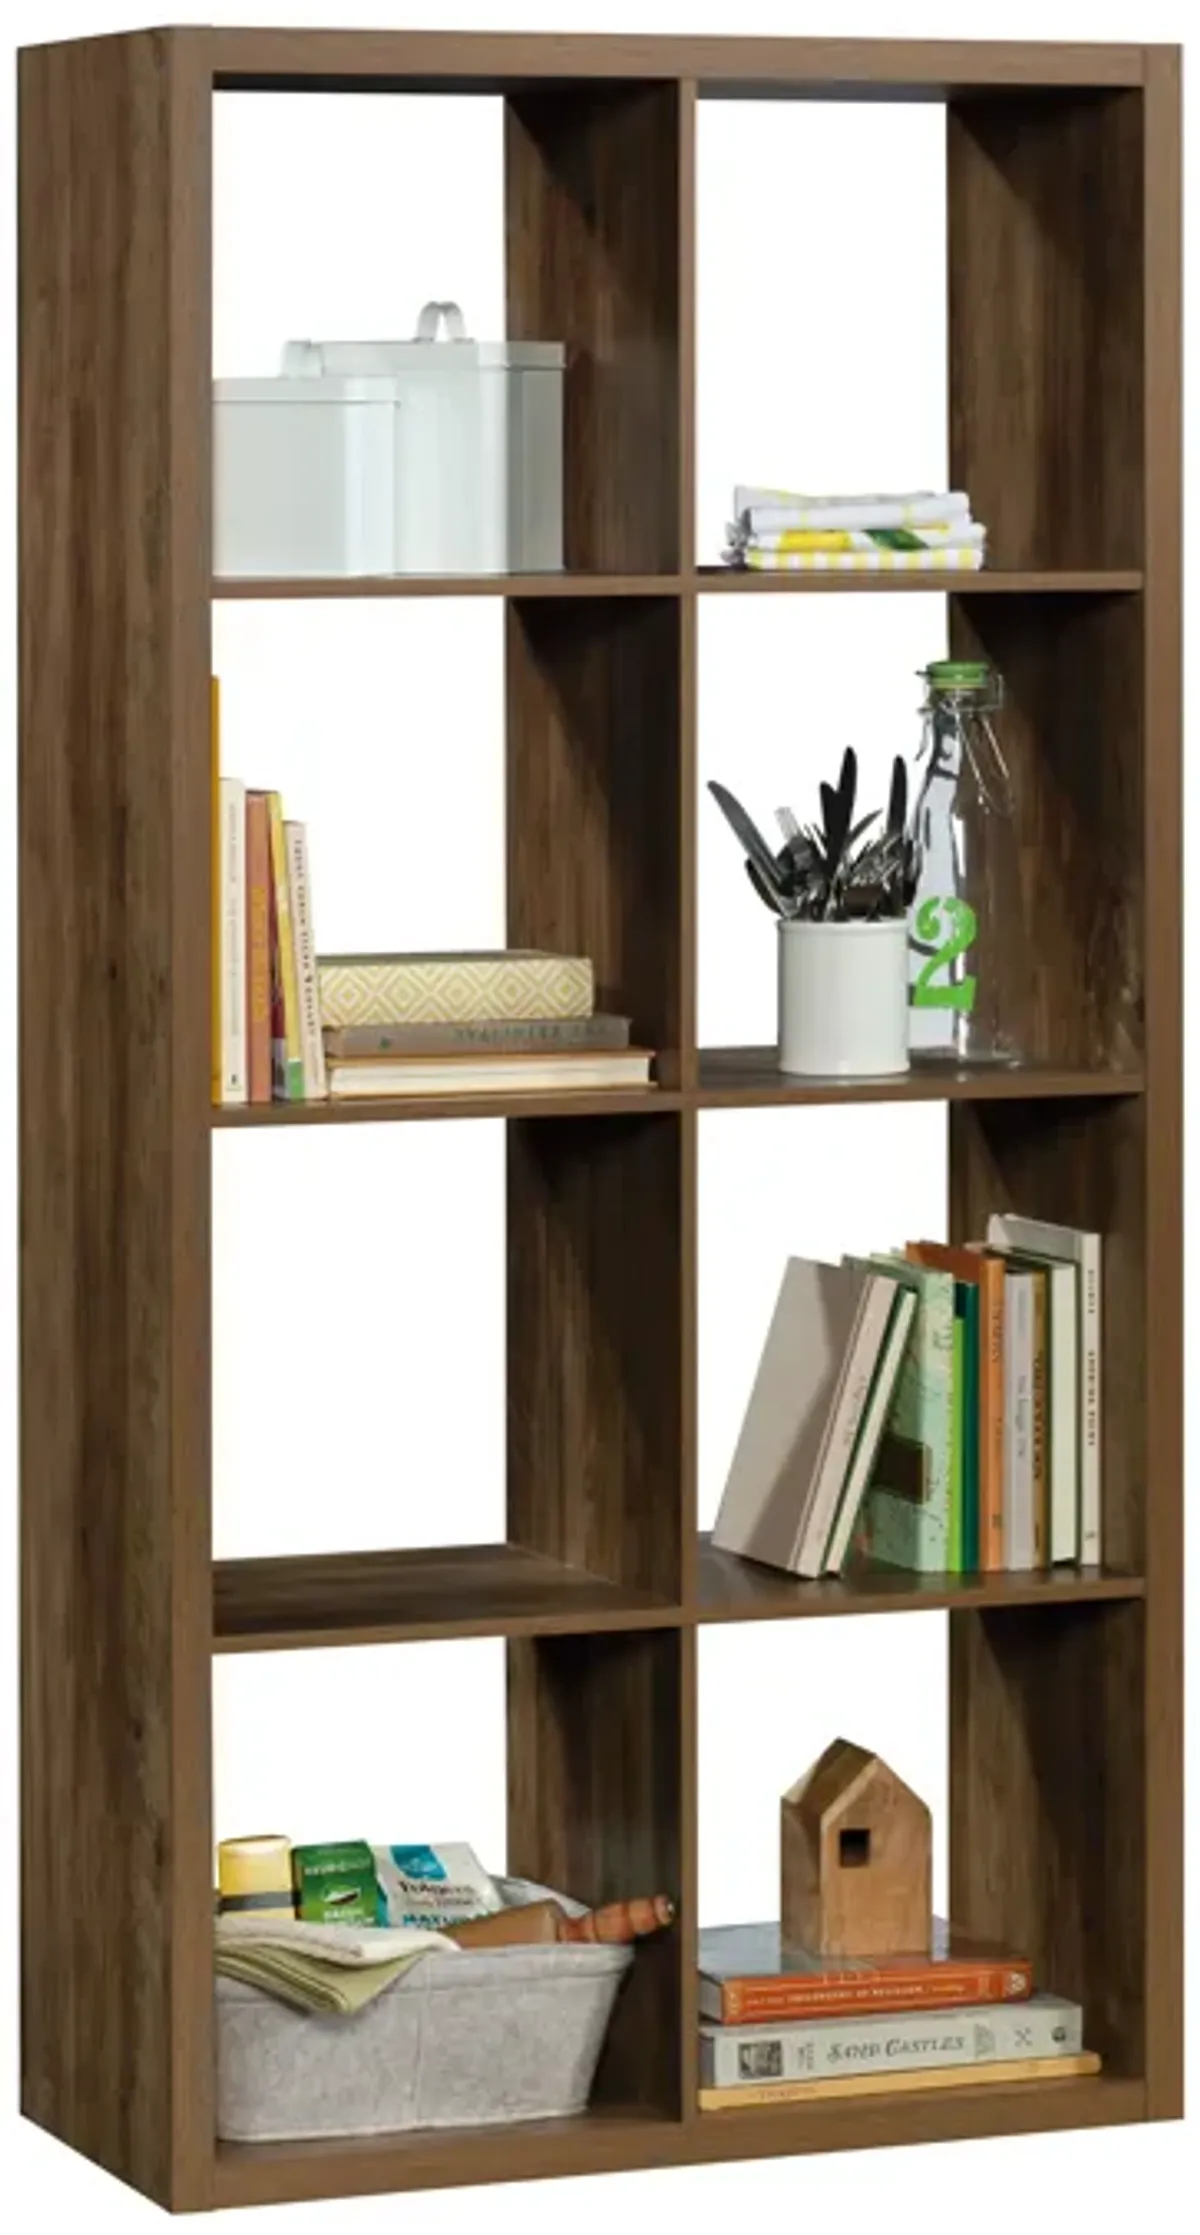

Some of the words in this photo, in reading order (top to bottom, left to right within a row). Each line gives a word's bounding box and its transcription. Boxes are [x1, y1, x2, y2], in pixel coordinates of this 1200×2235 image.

[913, 896, 977, 1011] 2
[826, 2042, 880, 2064] SAND
[885, 2036, 966, 2058] CASTLES
